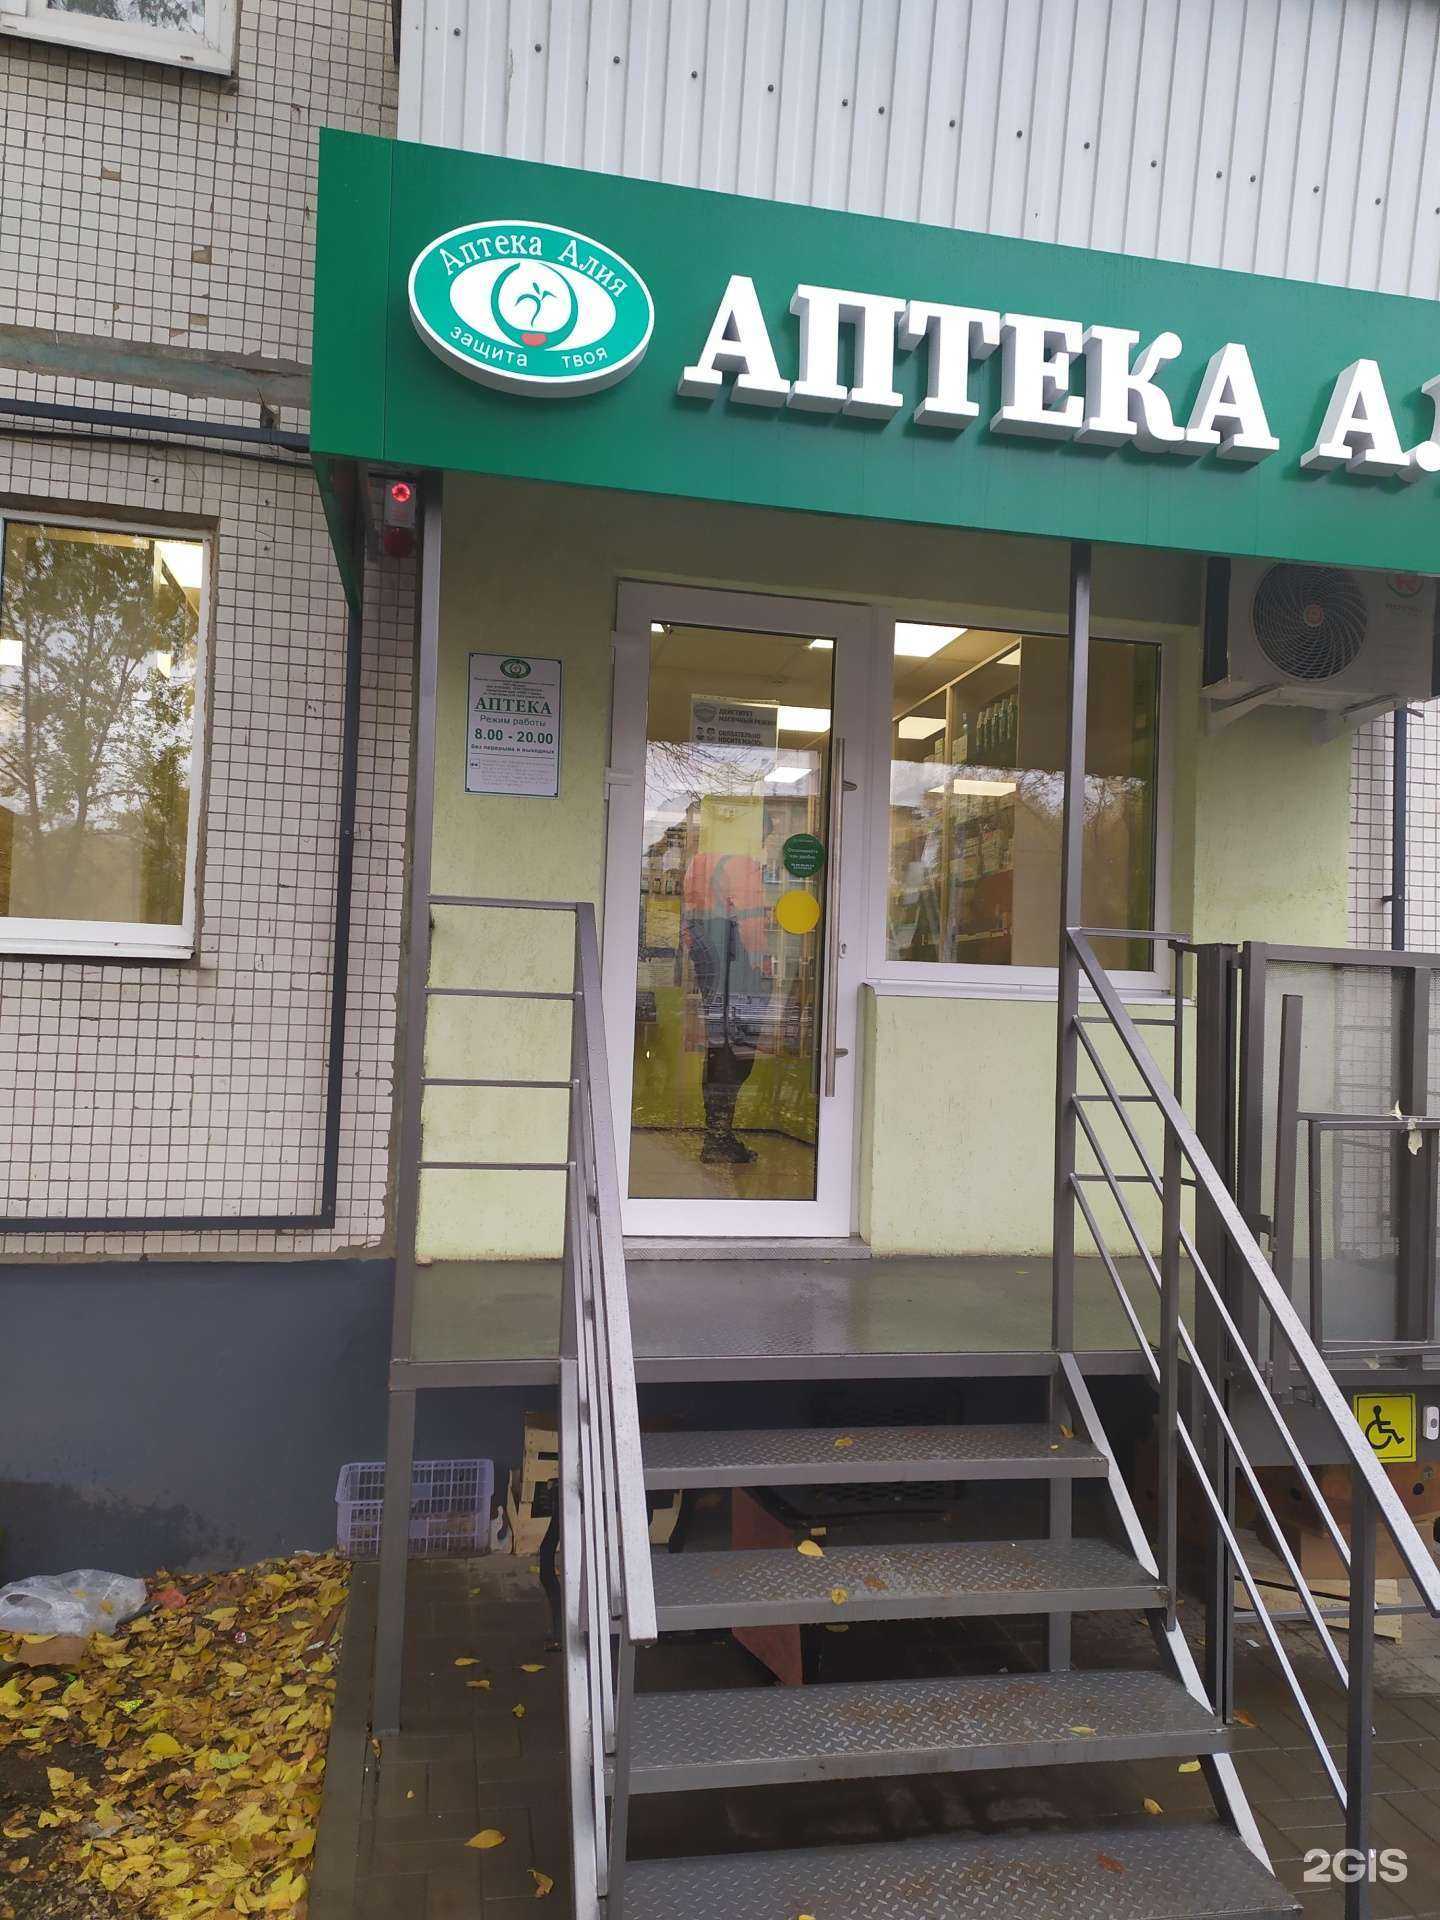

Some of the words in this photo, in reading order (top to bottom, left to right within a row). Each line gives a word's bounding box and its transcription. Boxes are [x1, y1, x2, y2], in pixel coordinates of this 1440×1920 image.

[438, 234, 543, 276] Аптека
[557, 239, 629, 298] Алия
[450, 326, 528, 368] защита
[561, 347, 608, 369] твоя
[678, 274, 1281, 460] АПТЕКА
[475, 696, 552, 715] АПТЕКА
[480, 714, 510, 726] Режим
[513, 718, 546, 728] работы
[474, 728, 504, 741] 8.00
[517, 731, 554, 745] 20.00
